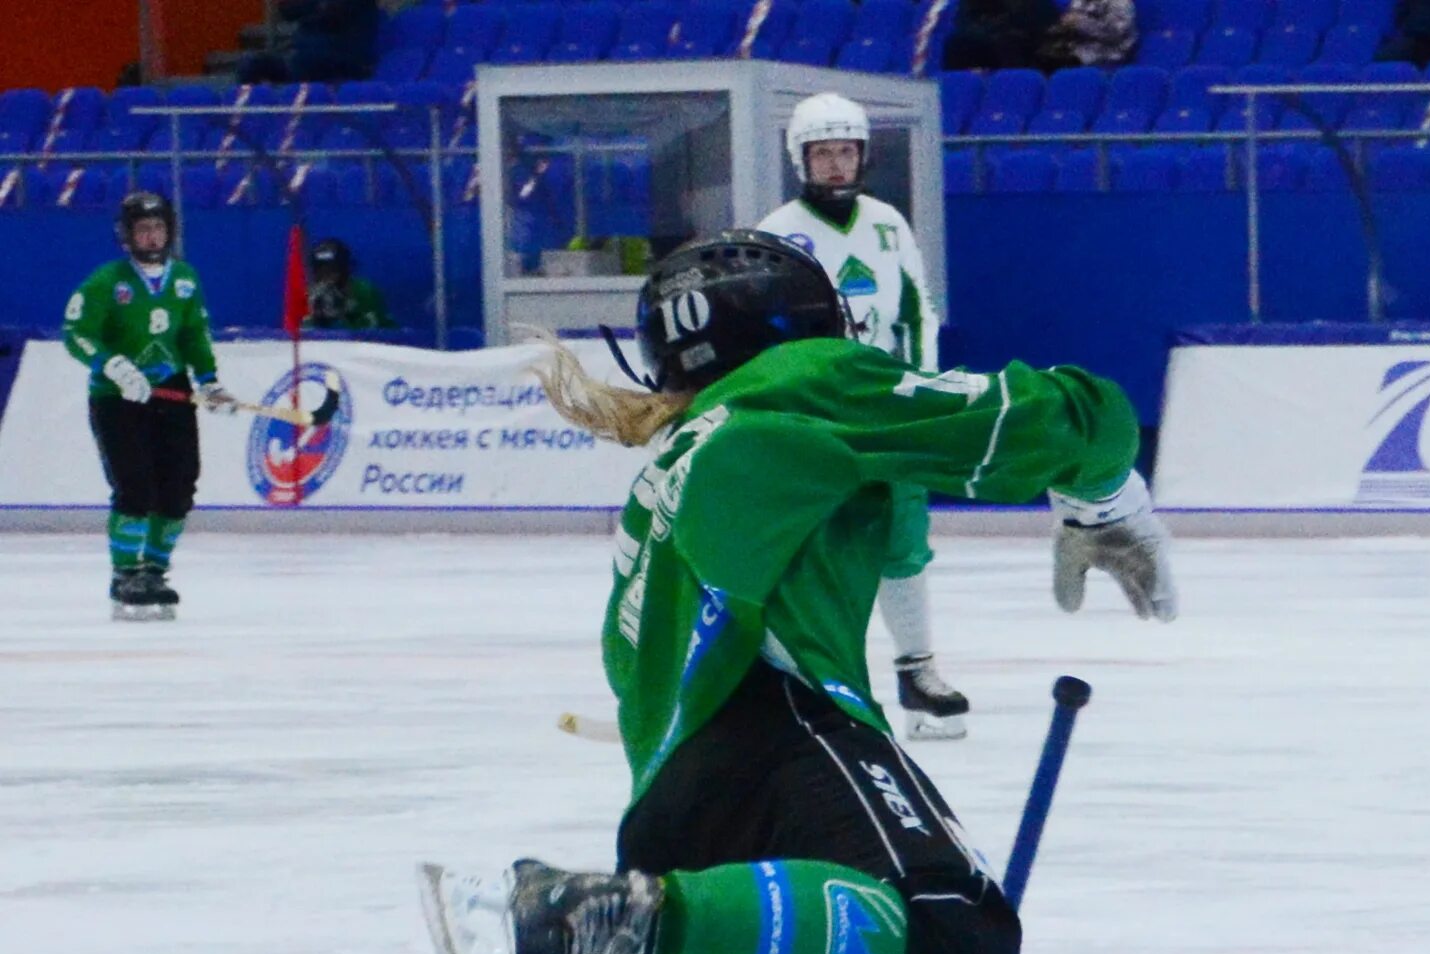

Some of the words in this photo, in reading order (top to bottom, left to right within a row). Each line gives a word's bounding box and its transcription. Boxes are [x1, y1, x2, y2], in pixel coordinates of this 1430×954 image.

[149, 308, 170, 335] 8
[658, 289, 711, 344] 10
[369, 428, 469, 450] хоккея
[476, 428, 493, 450] с
[501, 428, 596, 450] мячом
[361, 463, 465, 494] России
